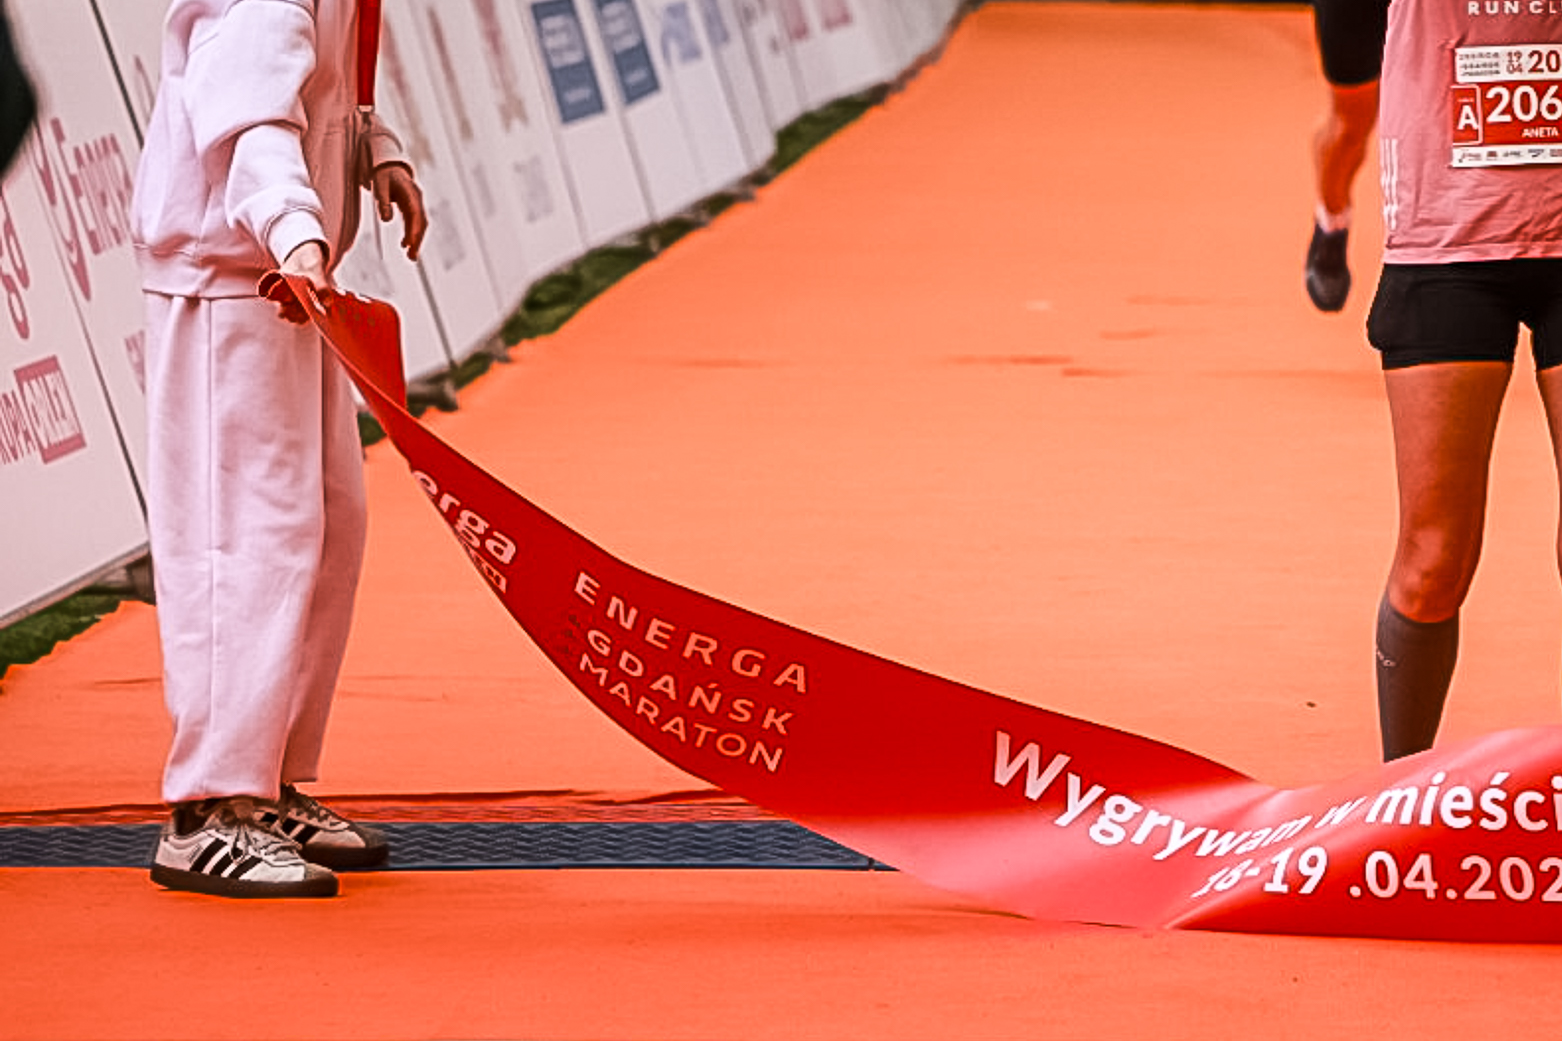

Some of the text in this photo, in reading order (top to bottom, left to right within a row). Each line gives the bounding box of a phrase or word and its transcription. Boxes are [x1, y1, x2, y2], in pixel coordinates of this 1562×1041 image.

[1467, 0, 1519, 16] RUN
[1457, 104, 1479, 130] A
[1521, 126, 1560, 138] ANETA
[411, 469, 518, 566] erga
[573, 569, 809, 694] ENERGA
[585, 628, 796, 736] GDAŃSK
[578, 652, 784, 774] MARATON
[991, 728, 1313, 865] Wygrywam
[1315, 795, 1368, 829] w
